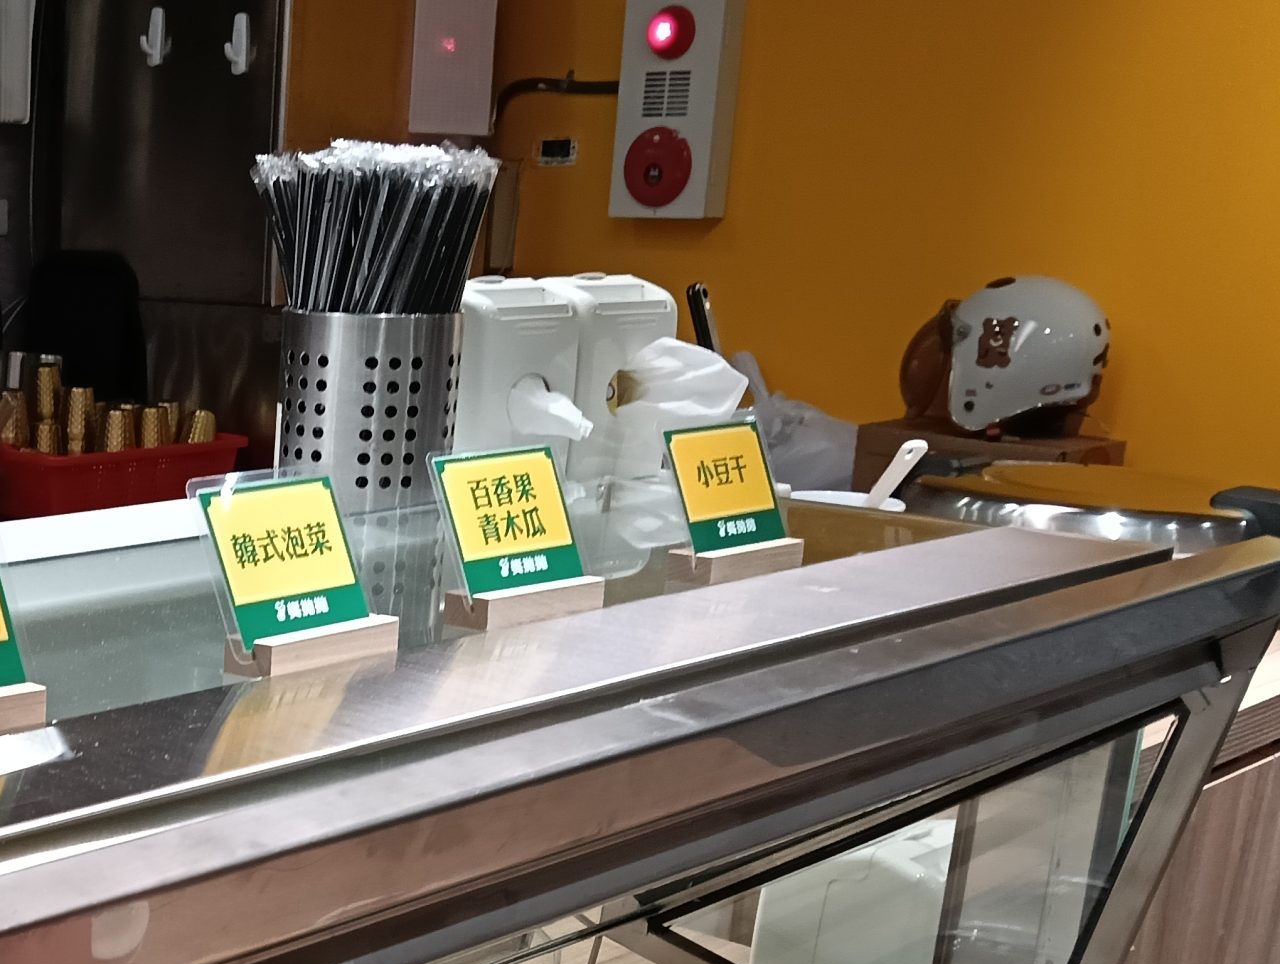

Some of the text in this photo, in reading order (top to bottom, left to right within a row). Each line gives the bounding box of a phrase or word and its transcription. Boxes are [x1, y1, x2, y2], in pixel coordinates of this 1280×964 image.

[696, 455, 746, 488] 小豆干
[467, 472, 537, 510] 百香果
[477, 507, 547, 545] 青木瓜
[230, 522, 332, 569] 韓式泡菜
